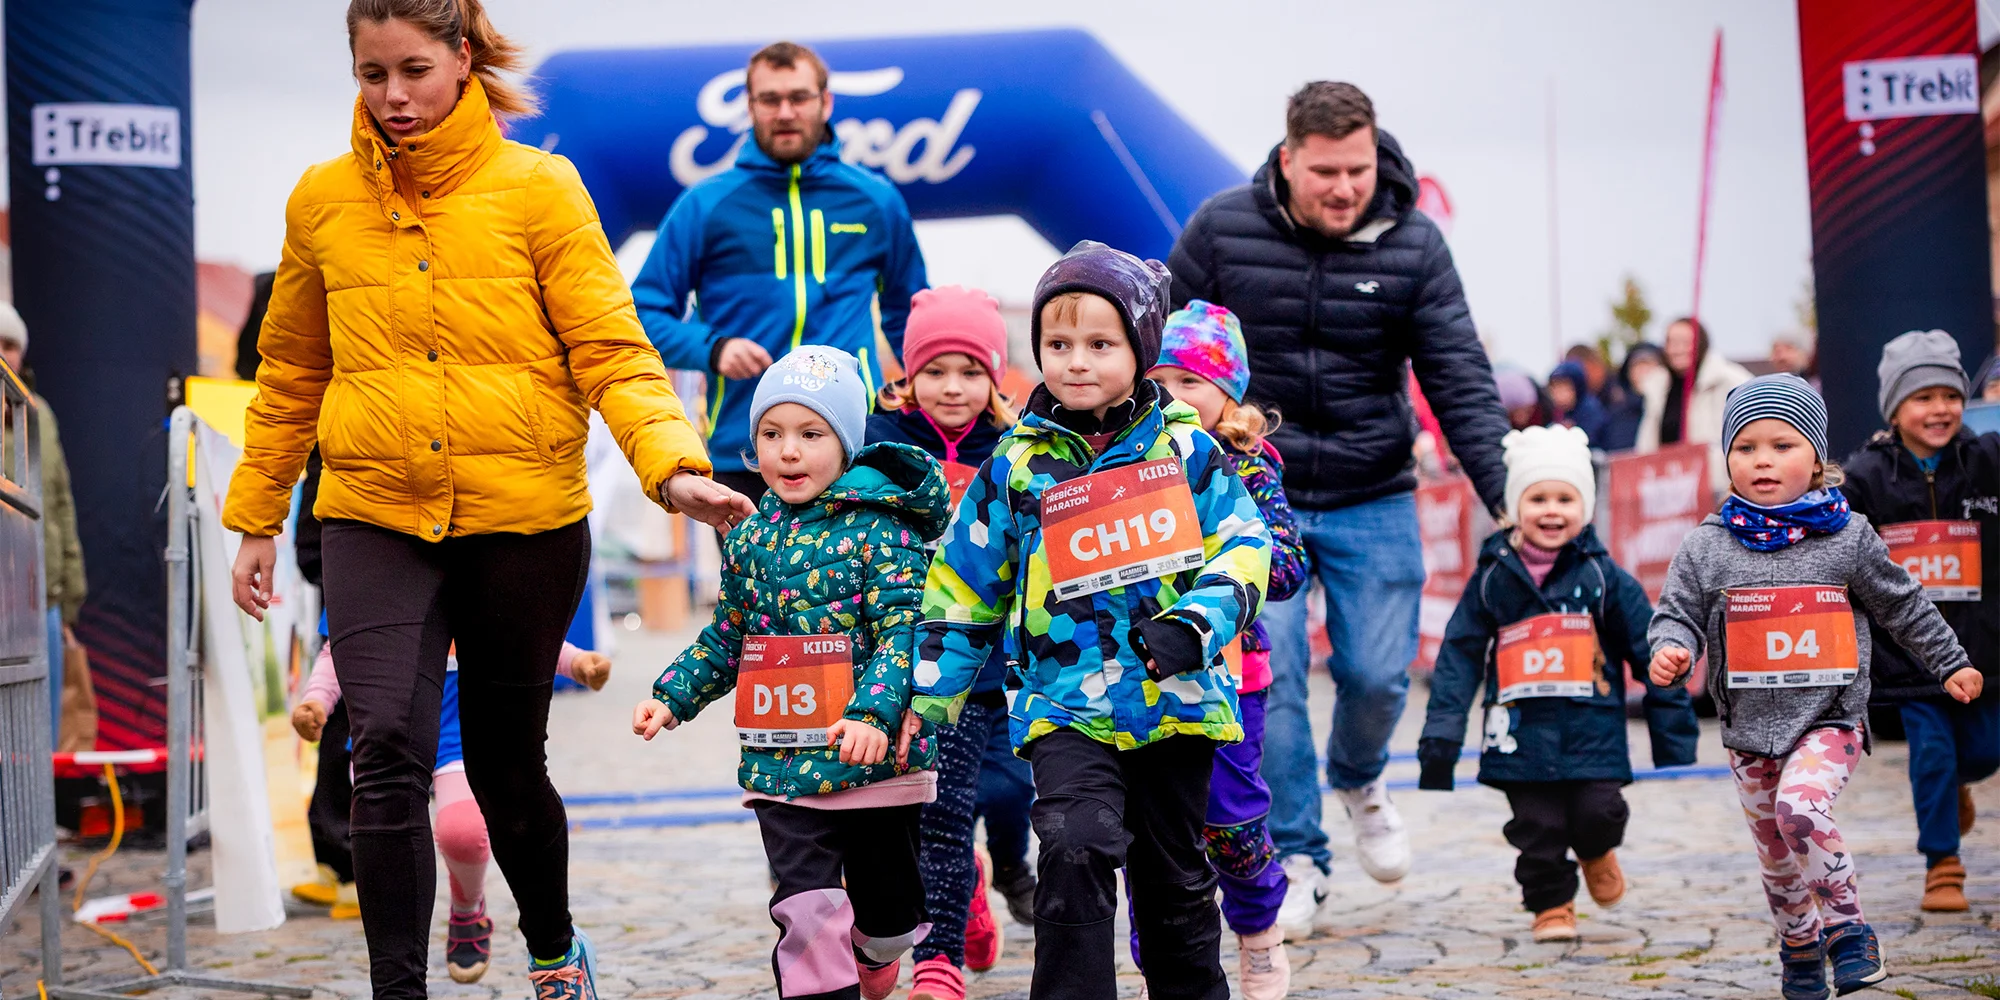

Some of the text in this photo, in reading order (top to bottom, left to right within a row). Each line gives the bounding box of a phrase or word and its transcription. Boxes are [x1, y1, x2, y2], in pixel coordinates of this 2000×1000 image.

[1882, 68, 1974, 103] Třebíč
[67, 117, 172, 153] Třebíč
[669, 66, 982, 187] Frd
[1137, 463, 1179, 482] KIDS
[1046, 481, 1092, 504] TŘEBÍČSKÝ
[1046, 495, 1089, 514] MARATON
[1069, 508, 1177, 562] CH19
[1730, 604, 1772, 612] MARATON
[1731, 593, 1776, 603] TŘEBÍČSKÝ
[1816, 591, 1846, 603] KIDS
[803, 640, 847, 654] KIDS
[1766, 629, 1820, 660] D4
[1523, 647, 1565, 675] D2
[753, 683, 817, 716] D13
